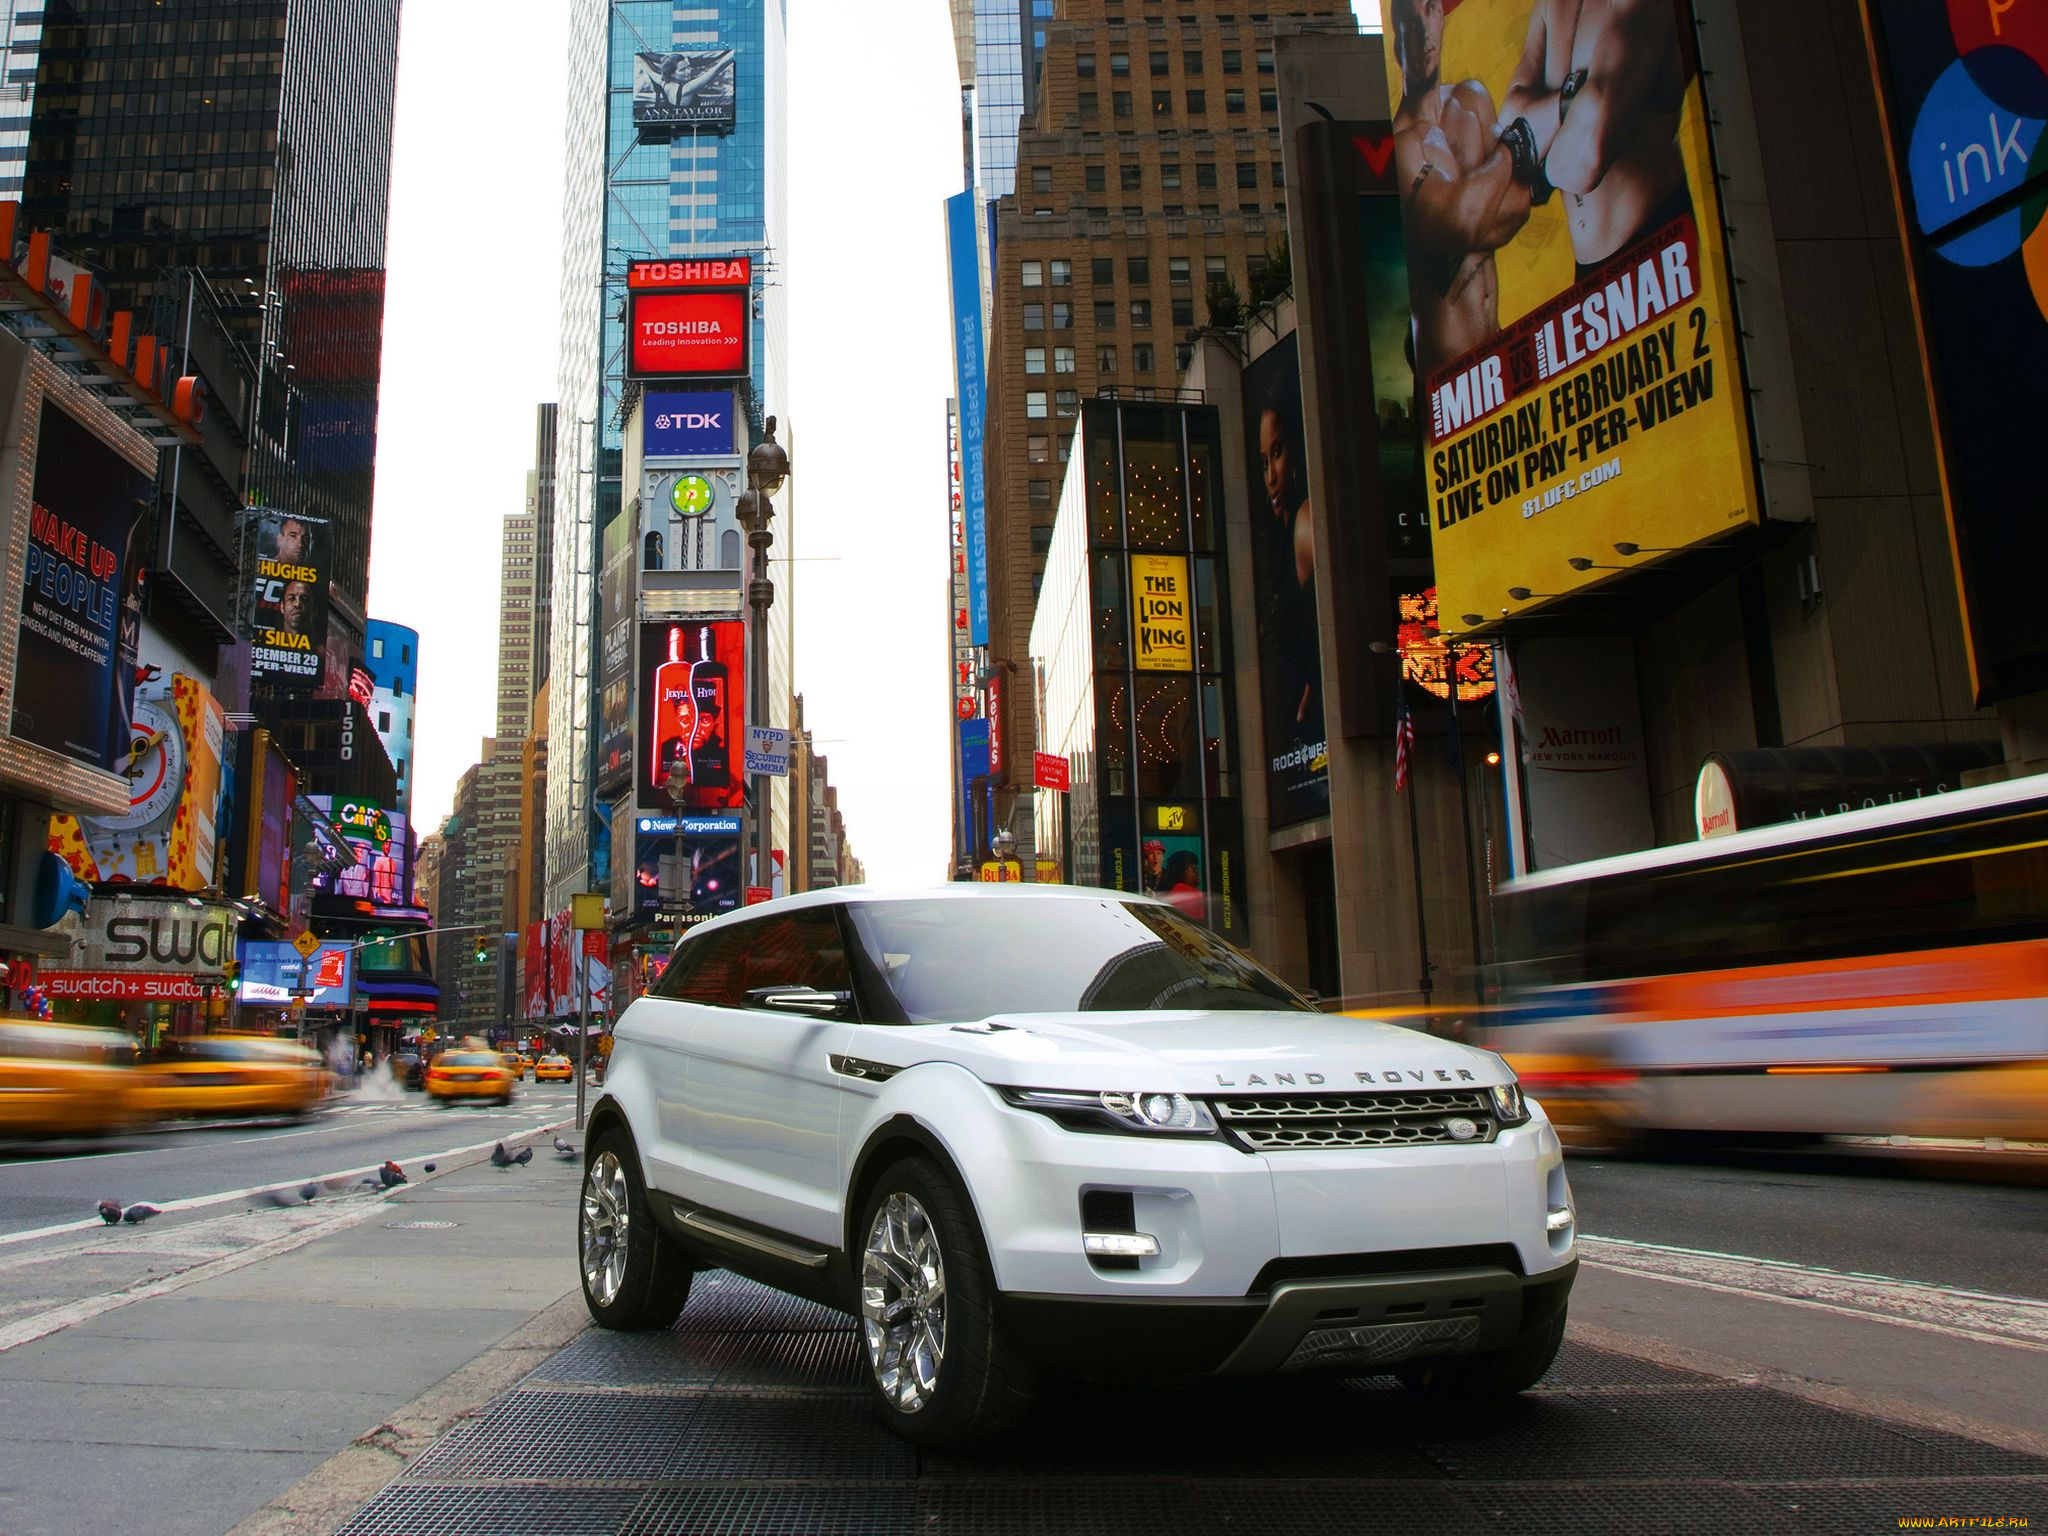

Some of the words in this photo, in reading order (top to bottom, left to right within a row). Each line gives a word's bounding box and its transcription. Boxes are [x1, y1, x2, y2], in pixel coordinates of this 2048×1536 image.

[645, 108, 670, 116] ANN
[673, 106, 722, 115] TAYLOR
[1940, 112, 2028, 203] ink
[634, 261, 744, 281] TOSHIBA
[643, 322, 721, 335] TOSHIBA
[1432, 390, 1443, 438] FRANK
[1440, 355, 1506, 435] MIR
[1510, 346, 1533, 383] VS
[1535, 330, 1548, 381] BROCK
[1543, 240, 1694, 376] LESNAR
[643, 338, 675, 347] Leading
[677, 338, 722, 346] Innovation
[962, 313, 977, 380] Market
[968, 381, 980, 438] Select
[1433, 397, 1549, 493] SATURDAY,
[1549, 321, 1677, 436] FEBRUARY
[1688, 306, 1710, 361] 2
[671, 413, 721, 429] TDK
[1437, 487, 1483, 530] LIVE
[1487, 463, 1521, 505] ON
[1525, 359, 1714, 487] PAY-PER-VIEW
[970, 445, 984, 502] Global
[1522, 457, 1621, 519] 81.UFC.COM
[270, 510, 329, 524] HAMPIONSHIP
[32, 501, 88, 567] WAKE
[91, 541, 117, 582] UP
[261, 560, 317, 583] HUGHES
[24, 542, 115, 630] PEOPLE
[1144, 576, 1176, 593] THE
[1139, 596, 1183, 624] LION
[20, 614, 47, 638] GINSENG
[47, 626, 62, 644] AND
[62, 634, 79, 653] MORE
[33, 602, 49, 620] NEW
[49, 610, 63, 627] DIET
[64, 617, 79, 634] PEPSI
[80, 625, 94, 641] MAX
[94, 632, 109, 650] WITH
[265, 630, 311, 650] SILVA
[604, 617, 632, 657] PLANET
[1141, 627, 1186, 655] KING
[303, 653, 319, 667] 29
[753, 730, 784, 741] NYPD
[1538, 726, 1622, 748] Marriott
[745, 750, 788, 764] SECURITY
[746, 761, 785, 774] CAMERA
[1555, 752, 1585, 761] YORK
[1587, 752, 1638, 762] MARQUIS
[1040, 765, 1063, 777] ANYTIME
[682, 820, 737, 832] Corporation
[1158, 806, 1187, 830] MTV
[1701, 809, 1730, 836] Marriott
[984, 869, 1018, 883] BUBA
[655, 912, 720, 922] Pansoni
[52, 977, 125, 994] swatch
[1215, 1072, 1325, 1086] LAND
[1353, 1069, 1476, 1084] ROVER
